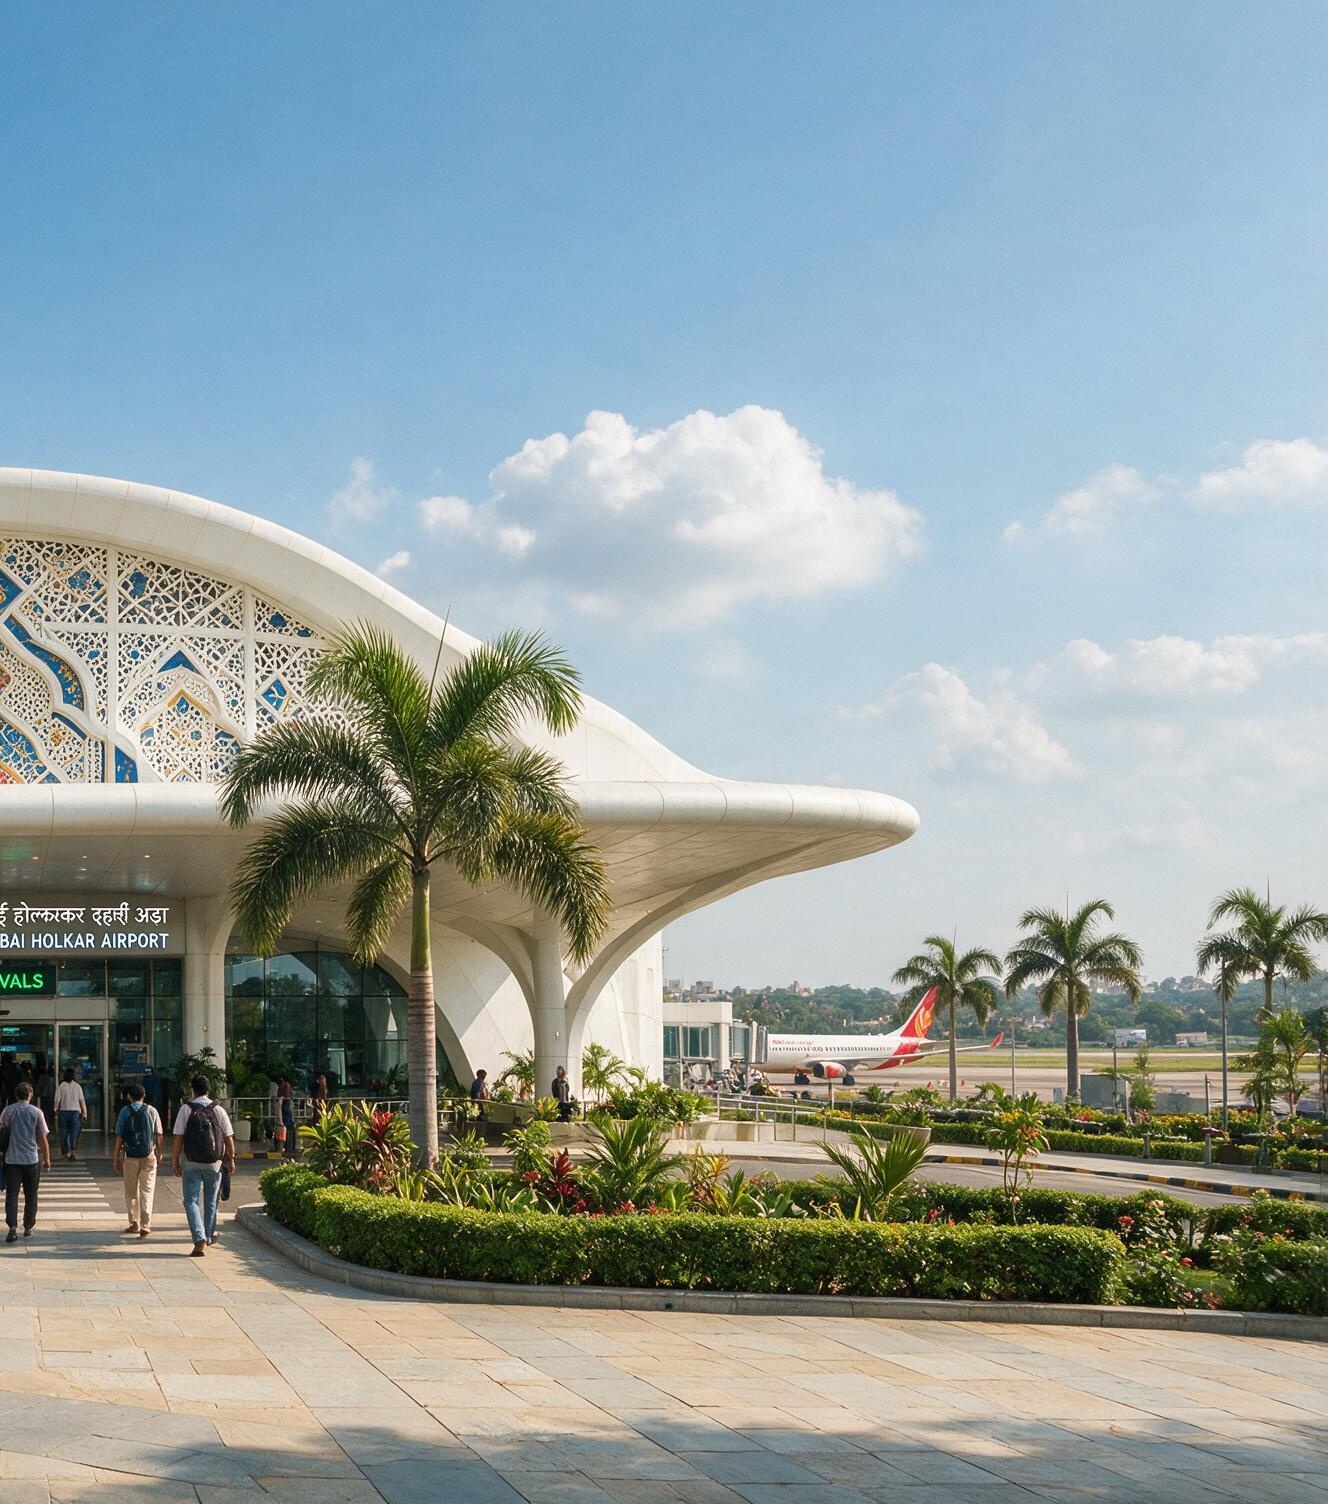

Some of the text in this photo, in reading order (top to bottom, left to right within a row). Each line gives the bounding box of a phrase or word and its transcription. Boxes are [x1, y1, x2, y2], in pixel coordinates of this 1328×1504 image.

[0, 933, 24, 948] BAI
[32, 933, 94, 948] HOLKAR
[101, 933, 169, 948] AIRPORT
